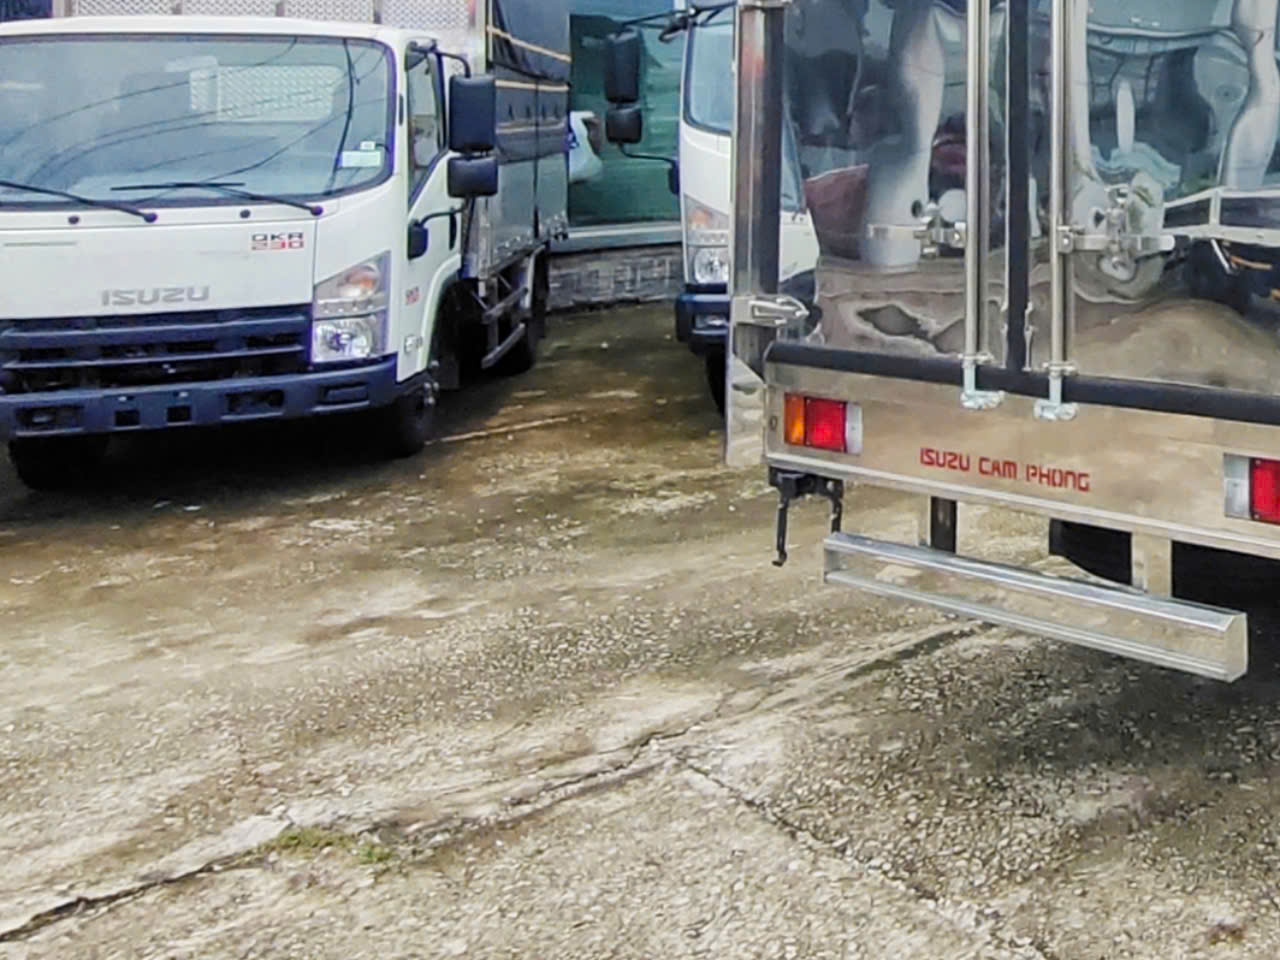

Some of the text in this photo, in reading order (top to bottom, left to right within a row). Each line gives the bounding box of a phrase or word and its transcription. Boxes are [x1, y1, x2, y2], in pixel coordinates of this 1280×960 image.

[102, 287, 209, 306] ISUZU
[920, 447, 1091, 492] ISUZU CAM PHONG
